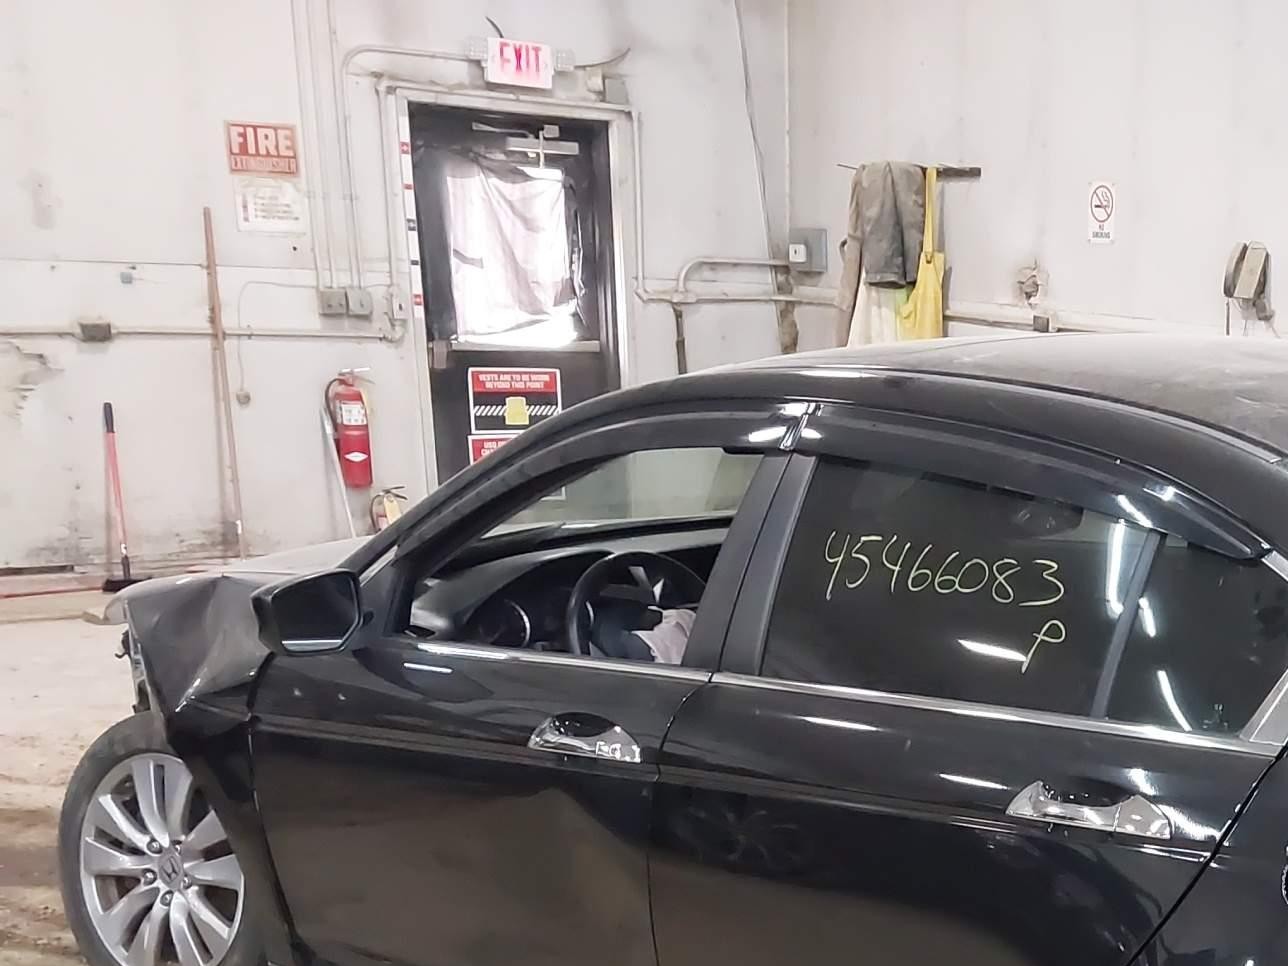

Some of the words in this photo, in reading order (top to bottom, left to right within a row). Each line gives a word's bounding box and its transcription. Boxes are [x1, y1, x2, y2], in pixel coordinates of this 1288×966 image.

[499, 41, 542, 74] EXIT
[229, 125, 295, 156] FIRE
[823, 530, 1066, 607] 45466083
